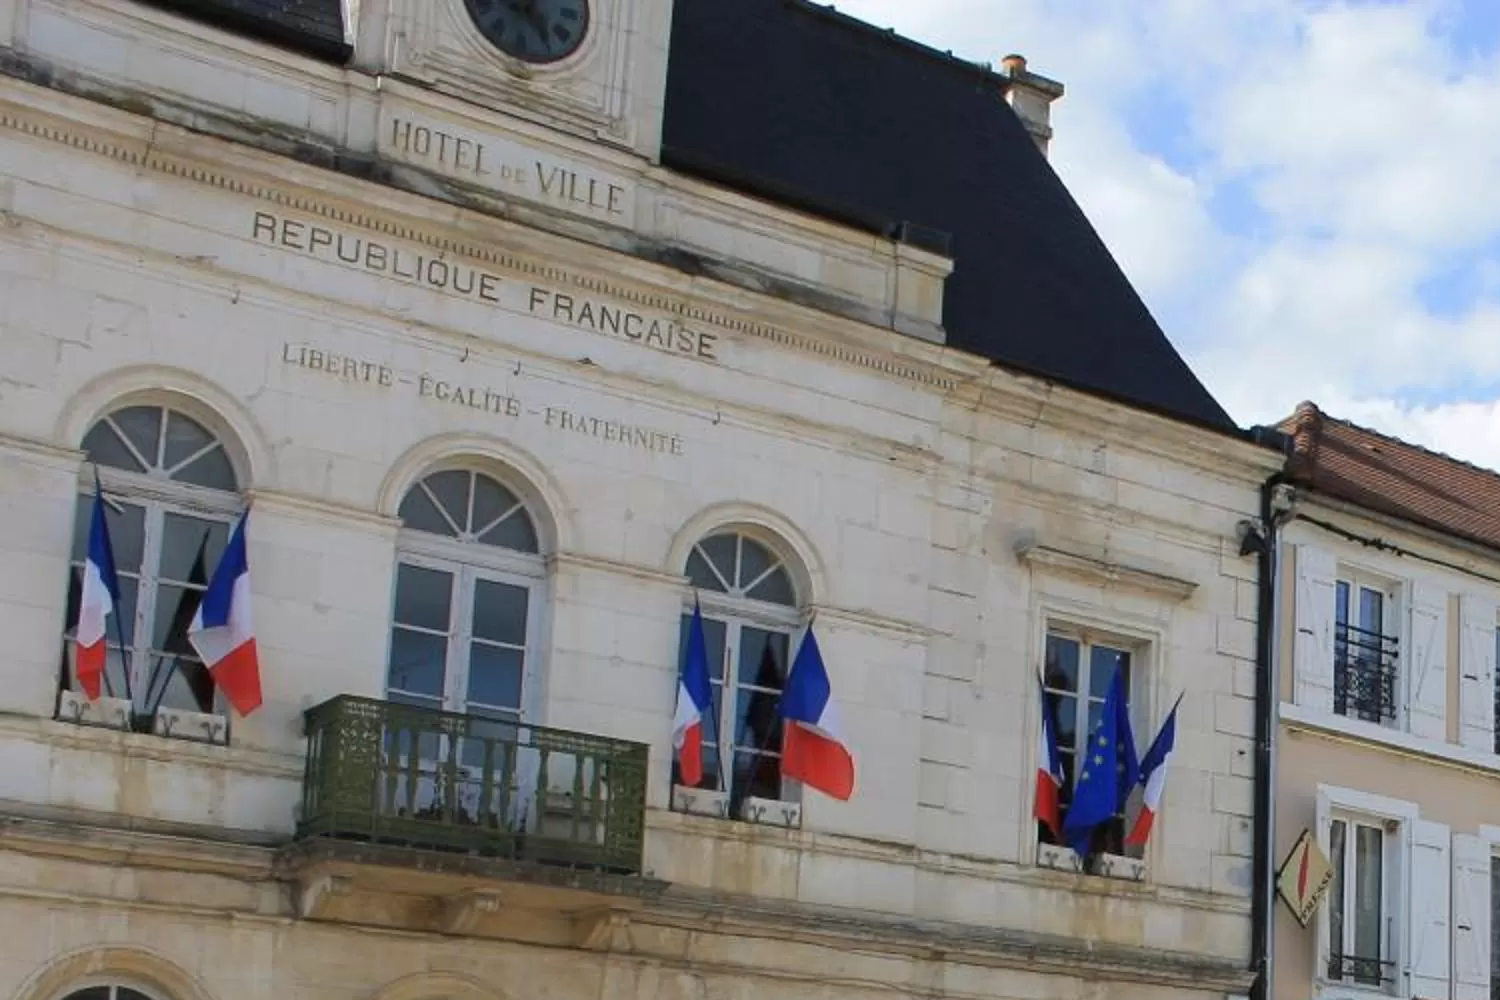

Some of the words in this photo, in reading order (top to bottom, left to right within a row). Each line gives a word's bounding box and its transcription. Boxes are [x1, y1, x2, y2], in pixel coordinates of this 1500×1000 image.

[392, 118, 491, 176] HOTEL
[535, 161, 624, 215] VILLE
[253, 211, 502, 302] REPUBLIQUE
